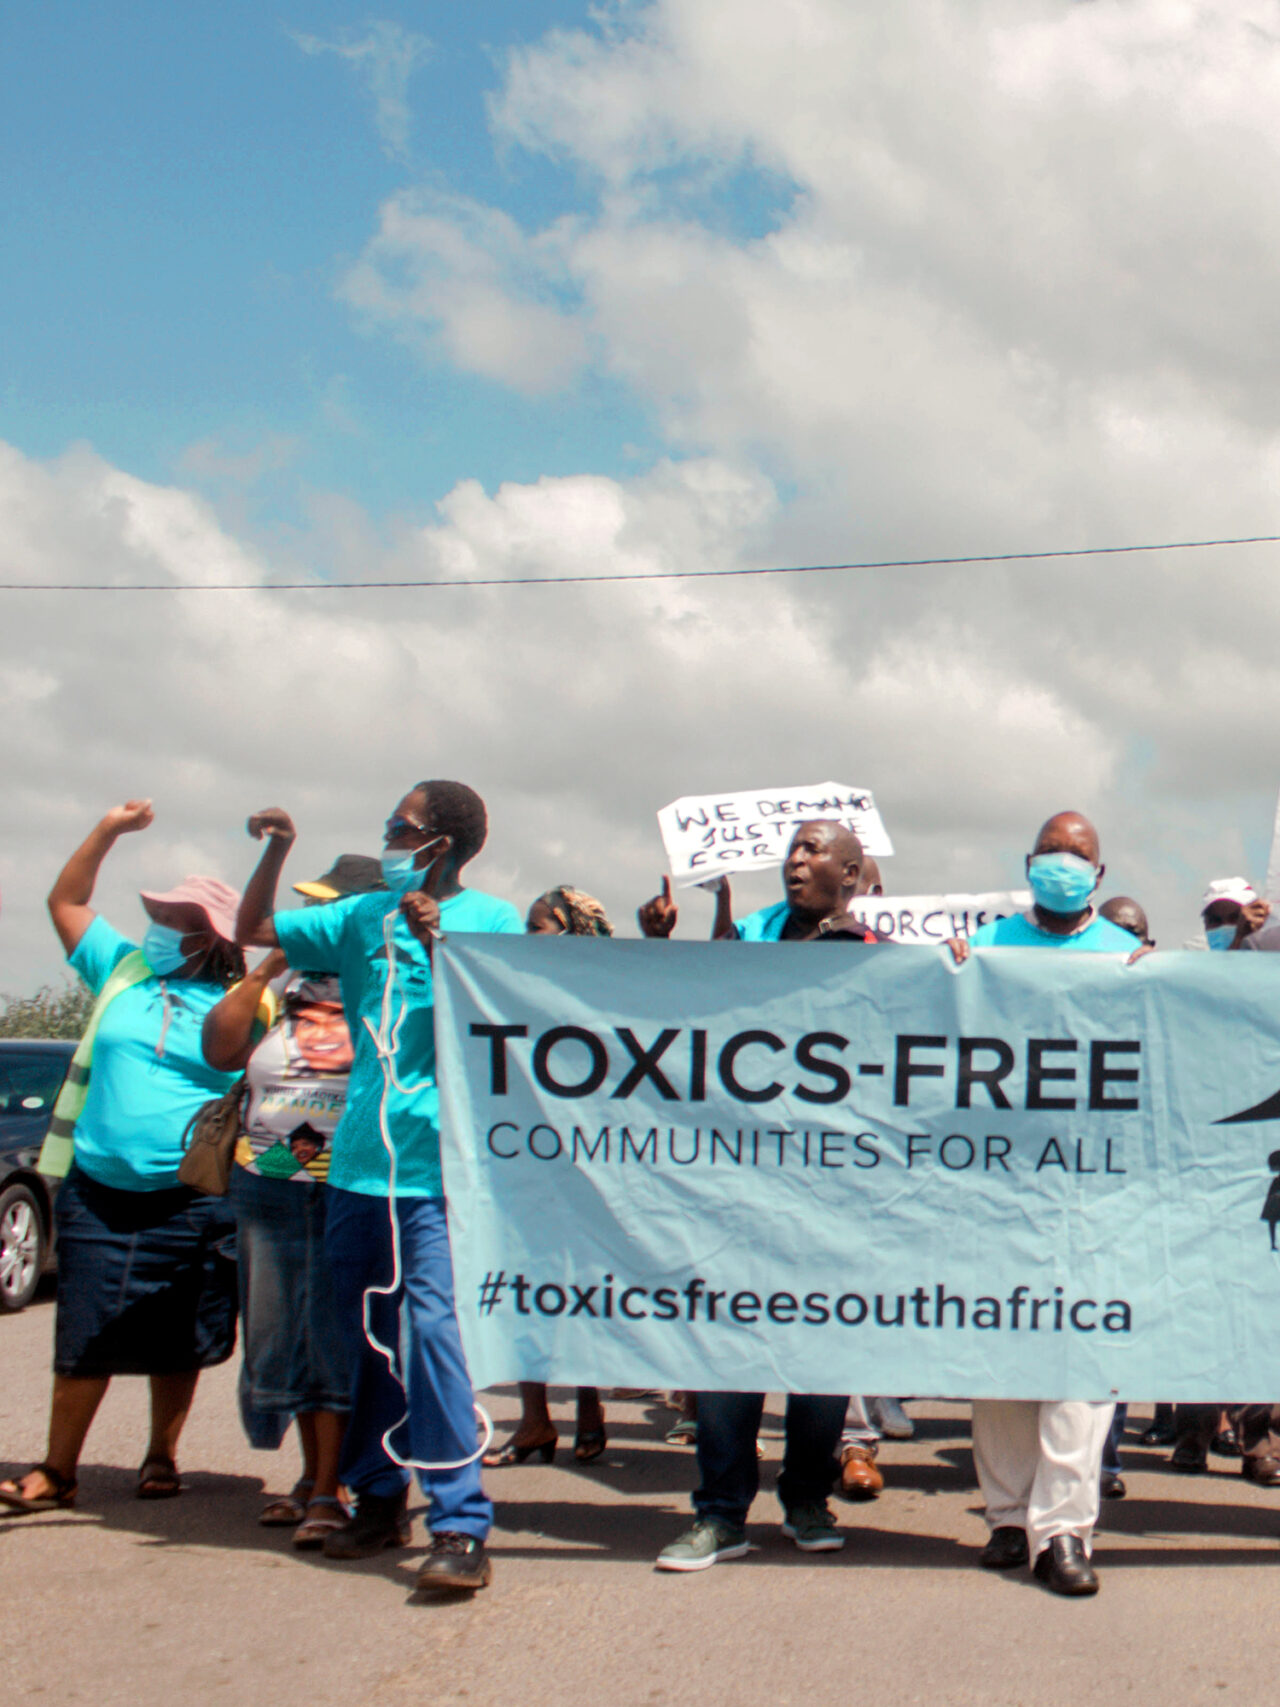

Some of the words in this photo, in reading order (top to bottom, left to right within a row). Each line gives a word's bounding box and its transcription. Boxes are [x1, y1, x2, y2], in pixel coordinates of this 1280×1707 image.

[675, 803, 741, 832] WE
[701, 817, 867, 848] JUSTE
[689, 844, 776, 869] FOR
[860, 909, 1007, 938] ORCHE
[468, 1022, 1142, 1111] TOXICS-FREE
[486, 1122, 881, 1169] COMMUNITIES
[905, 1133, 1013, 1173] FOR
[1034, 1135, 1127, 1175] ALL
[477, 1270, 1132, 1333] #toxicsfreesouthafrica
